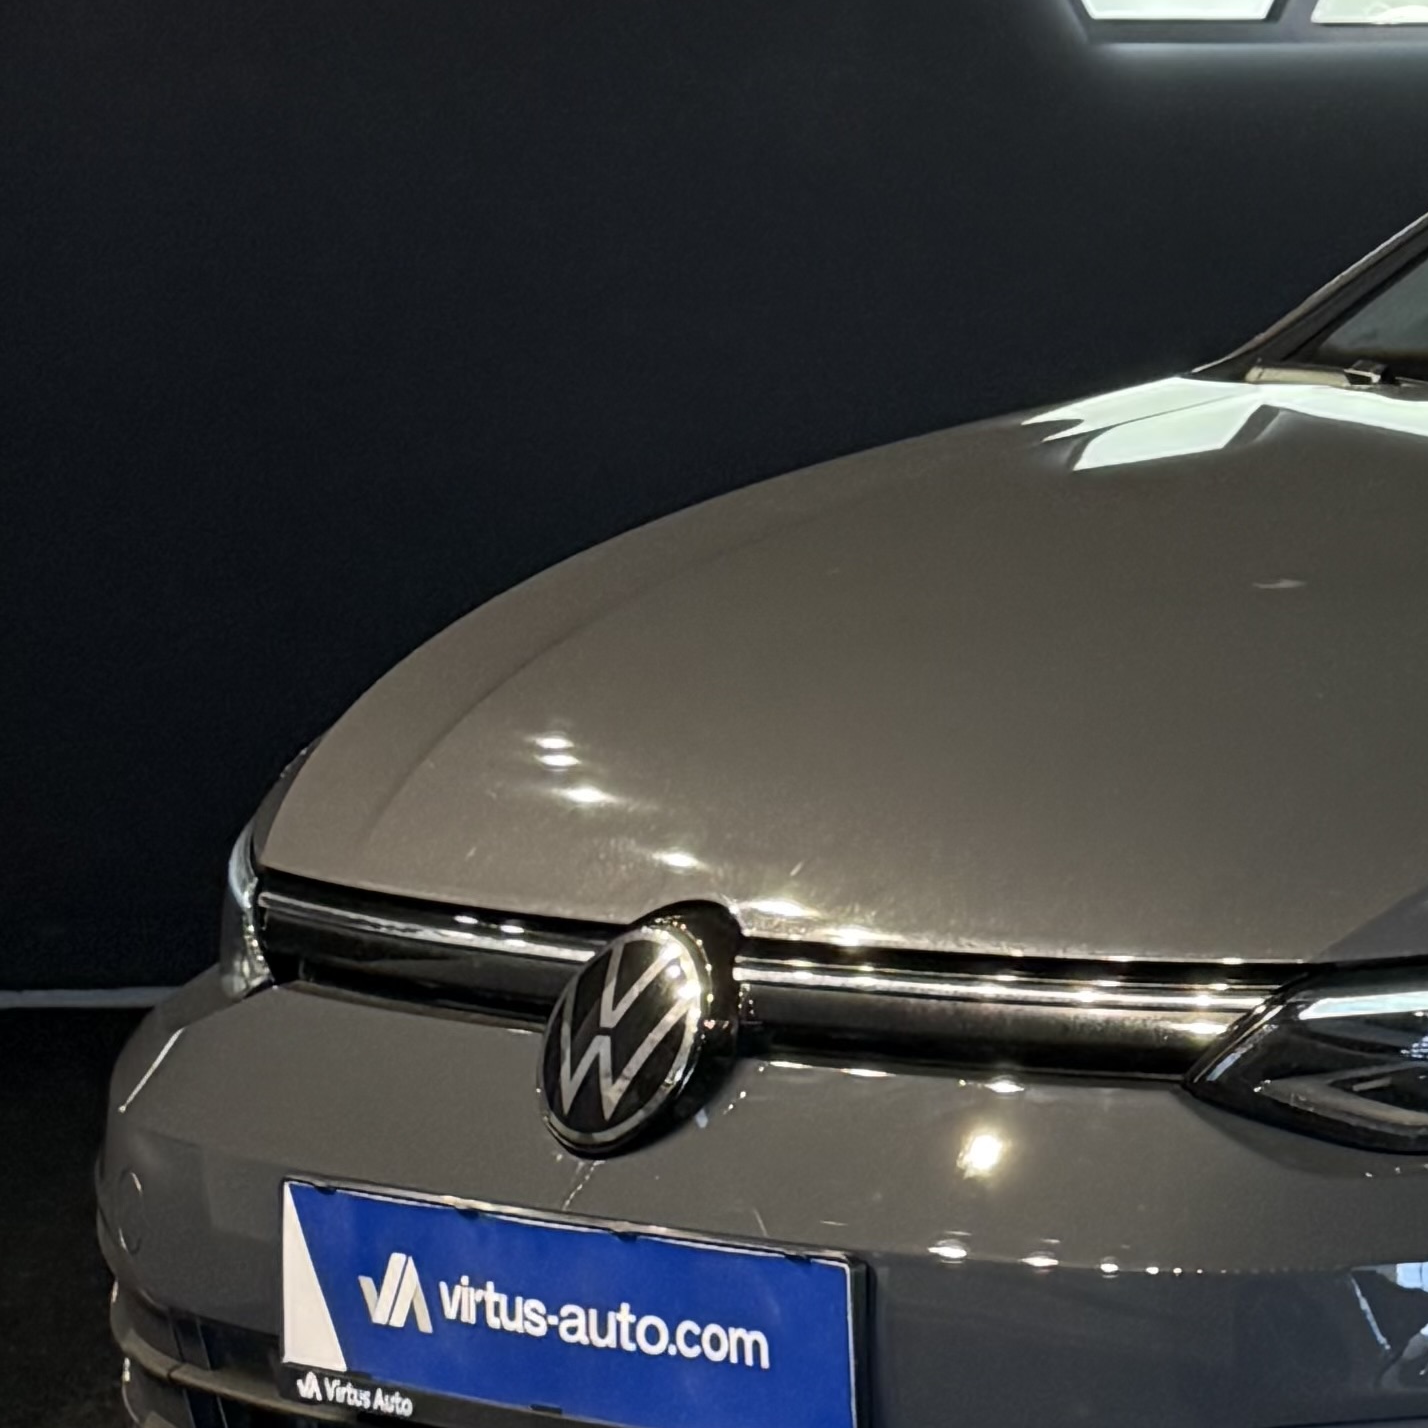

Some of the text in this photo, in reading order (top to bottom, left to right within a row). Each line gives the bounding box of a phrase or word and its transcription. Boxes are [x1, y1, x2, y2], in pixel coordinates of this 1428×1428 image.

[438, 1275, 771, 1370] virtus-auto.com
[323, 1376, 371, 1410] Virtus
[372, 1387, 413, 1417] Auto
